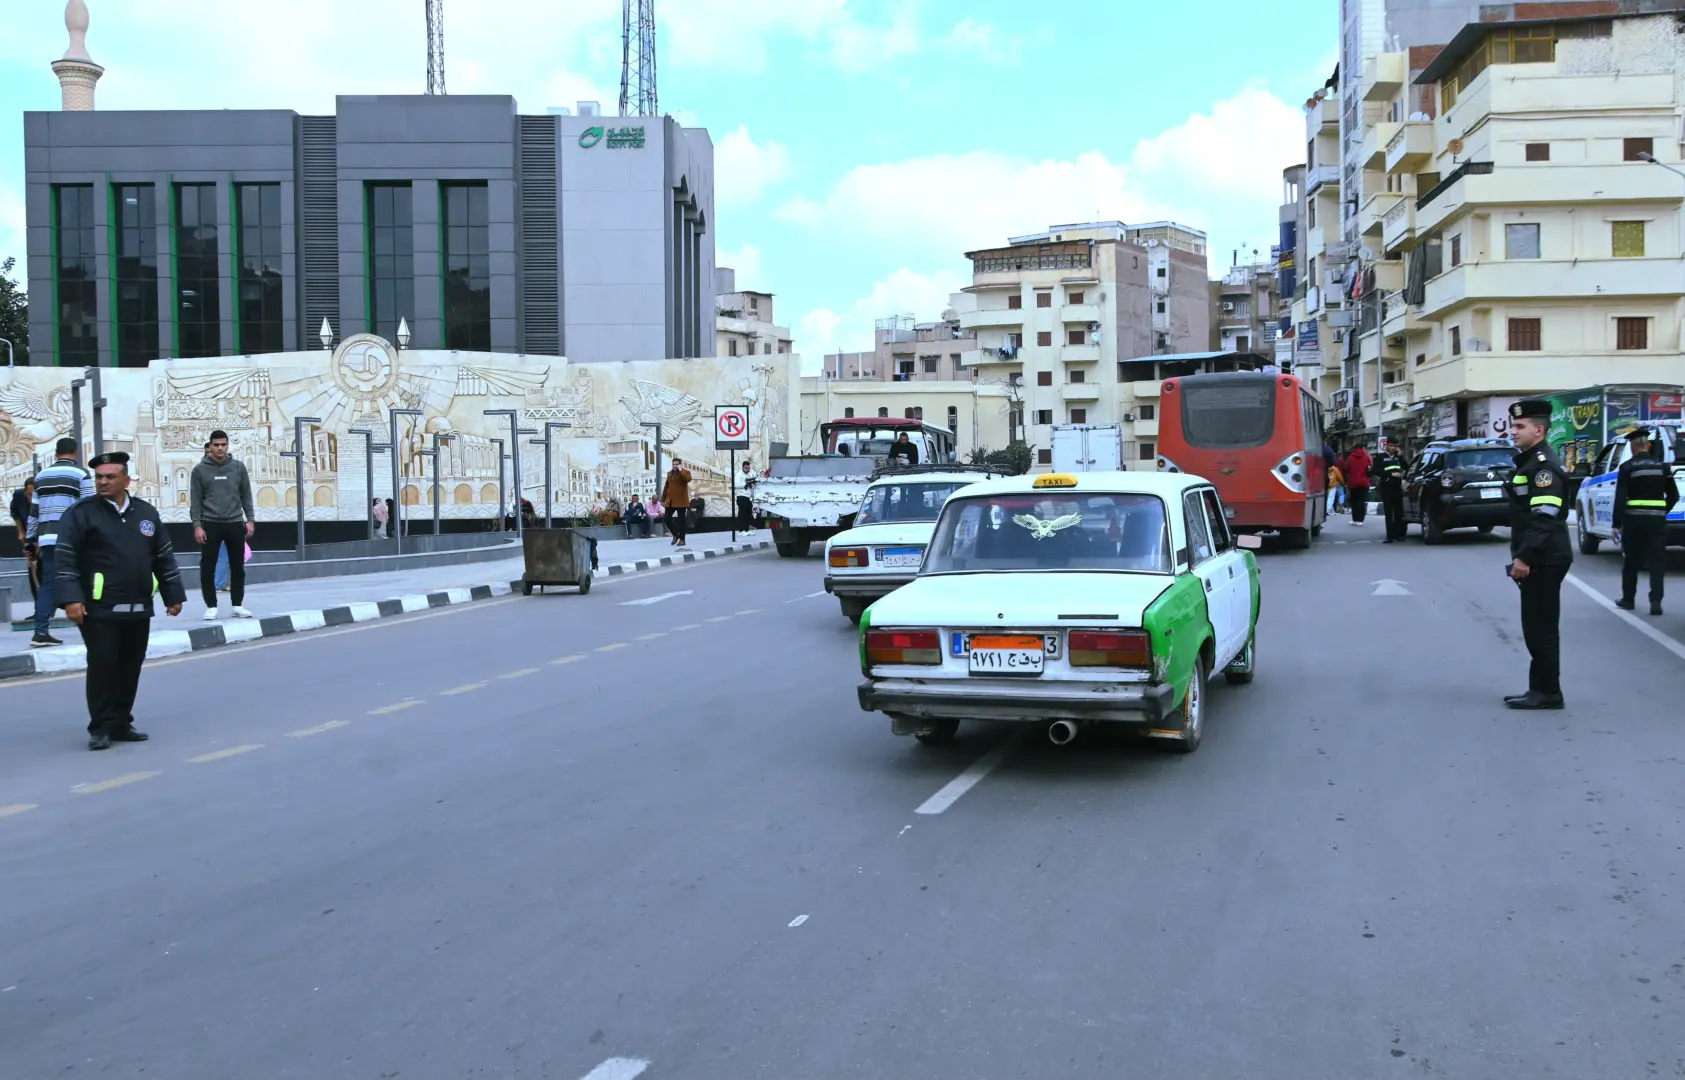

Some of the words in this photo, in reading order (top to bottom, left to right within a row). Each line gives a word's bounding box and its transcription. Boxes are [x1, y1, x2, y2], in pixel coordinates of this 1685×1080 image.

[728, 415, 739, 432] P
[1046, 637, 1057, 653] 3
[972, 651, 1002, 668] ٩٧٢١
